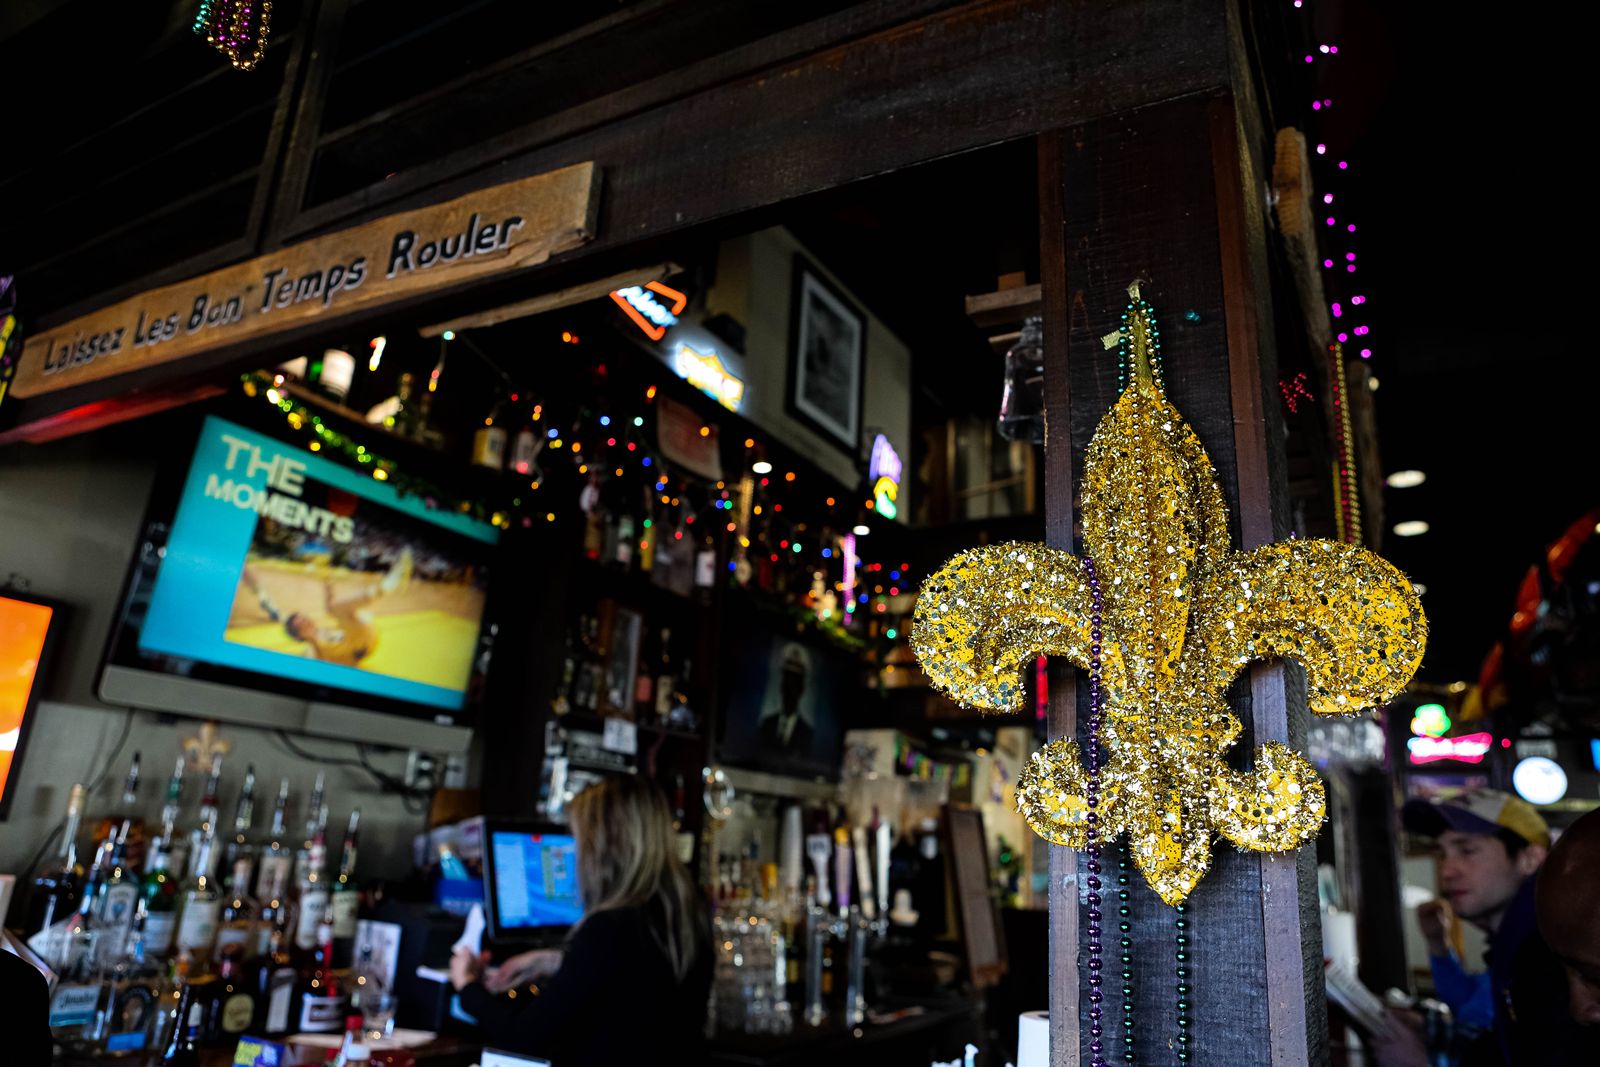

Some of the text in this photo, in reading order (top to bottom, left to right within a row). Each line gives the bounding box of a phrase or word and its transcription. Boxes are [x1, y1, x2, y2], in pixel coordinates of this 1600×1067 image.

[45, 326, 125, 373] Laissez
[133, 309, 179, 346] Les
[260, 256, 368, 310] Temps
[387, 213, 524, 277] Rouler
[221, 433, 308, 498] THE
[204, 472, 356, 544] MOMENTS
